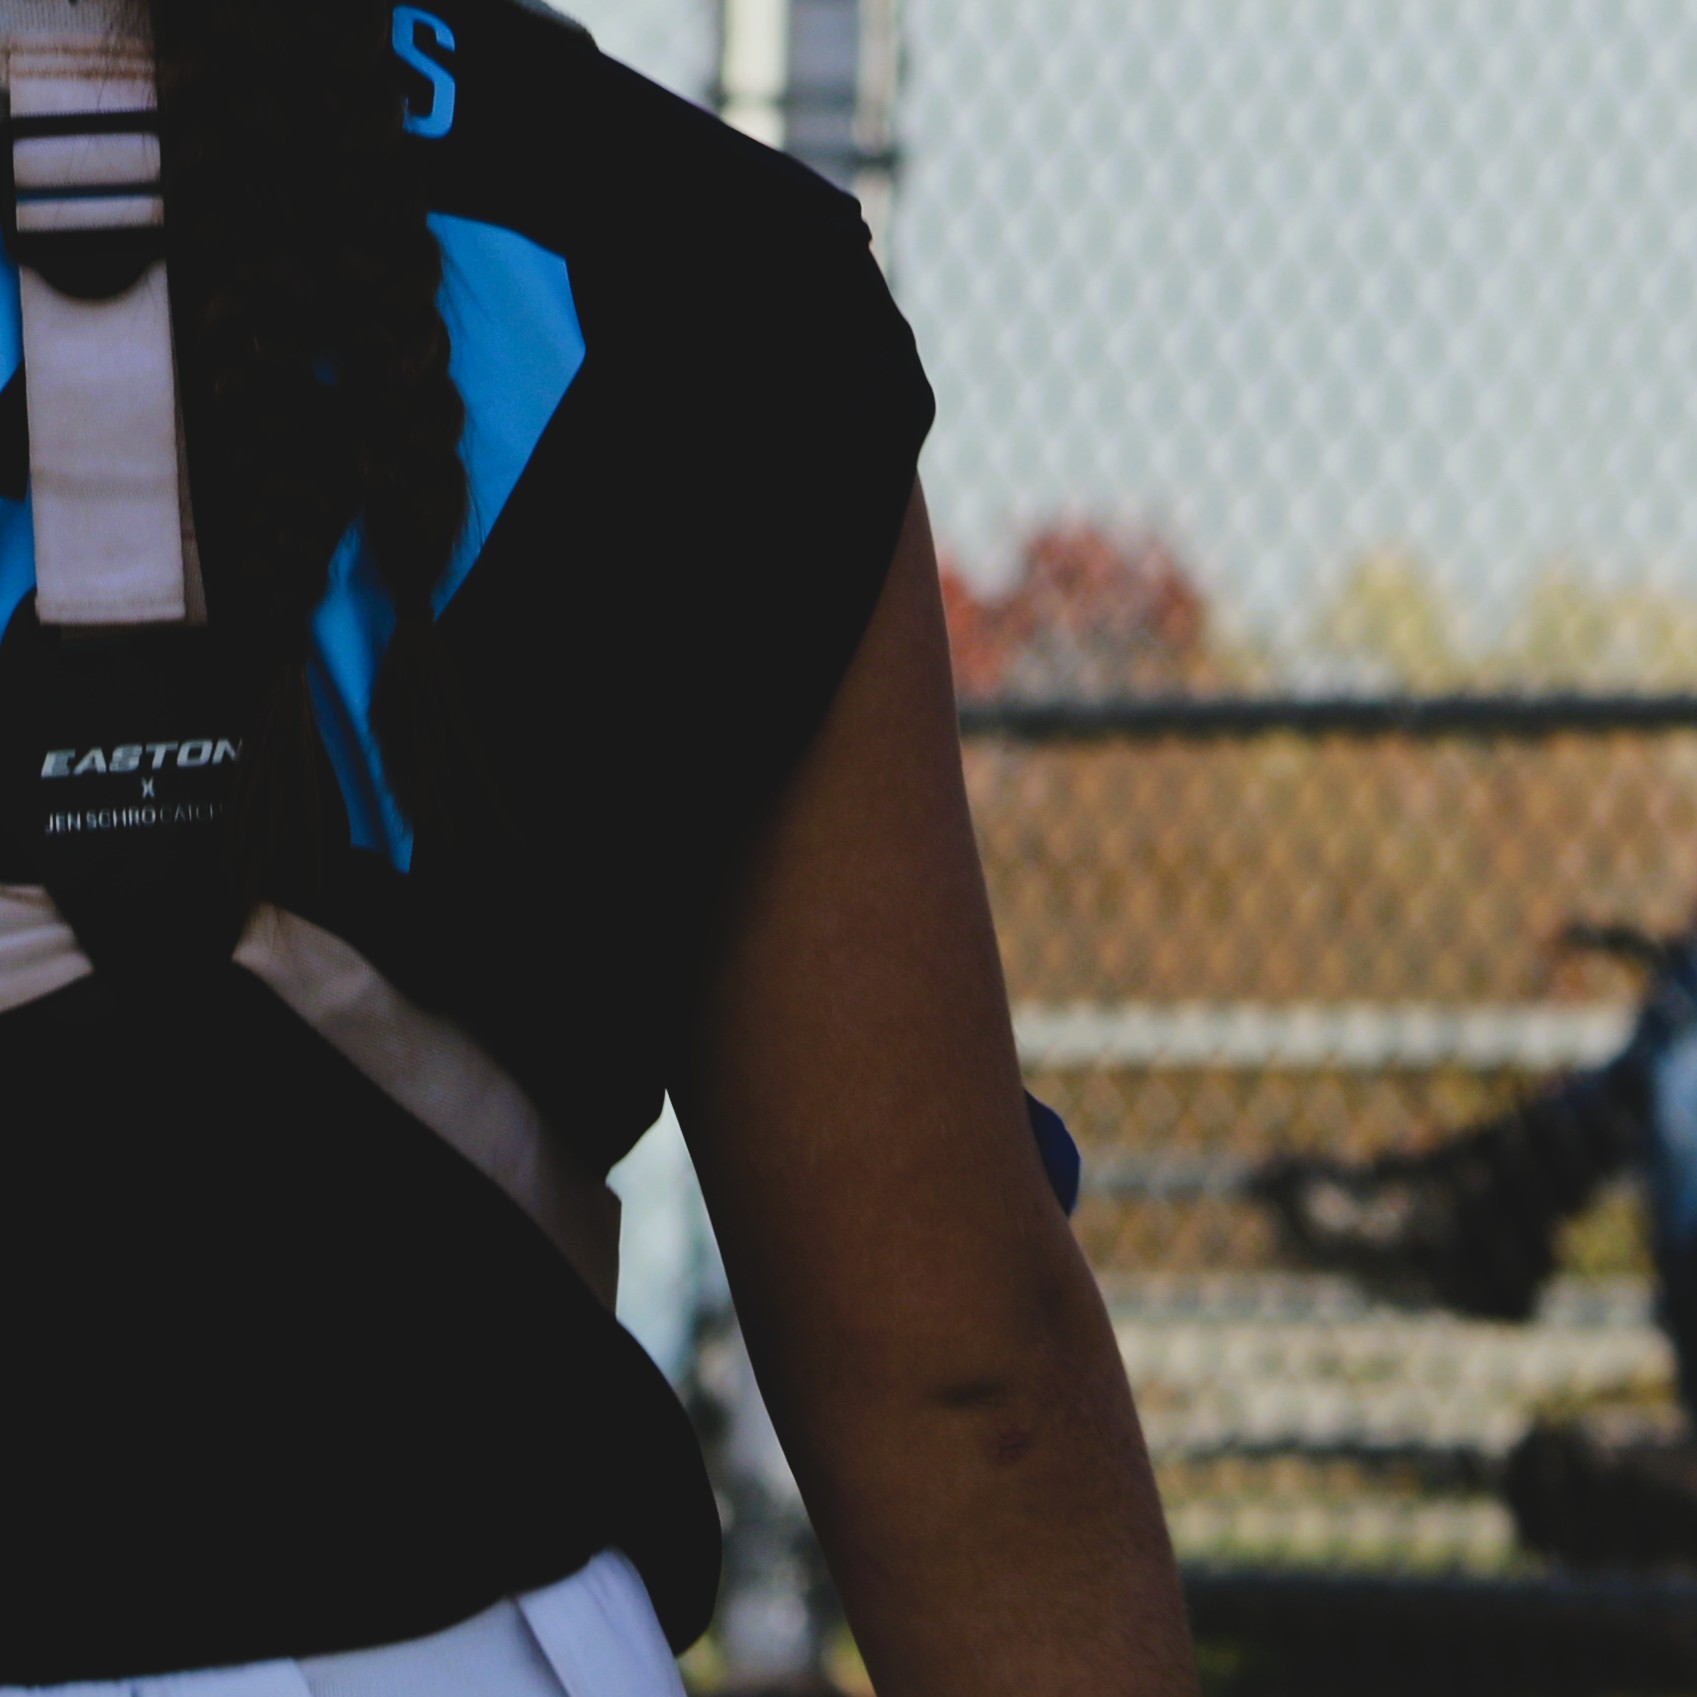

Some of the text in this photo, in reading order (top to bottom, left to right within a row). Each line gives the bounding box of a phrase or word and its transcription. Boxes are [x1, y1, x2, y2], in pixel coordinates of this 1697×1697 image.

[40, 738, 243, 779] EASTON
[45, 810, 82, 838] JEN
[86, 805, 156, 831] SCHRO
